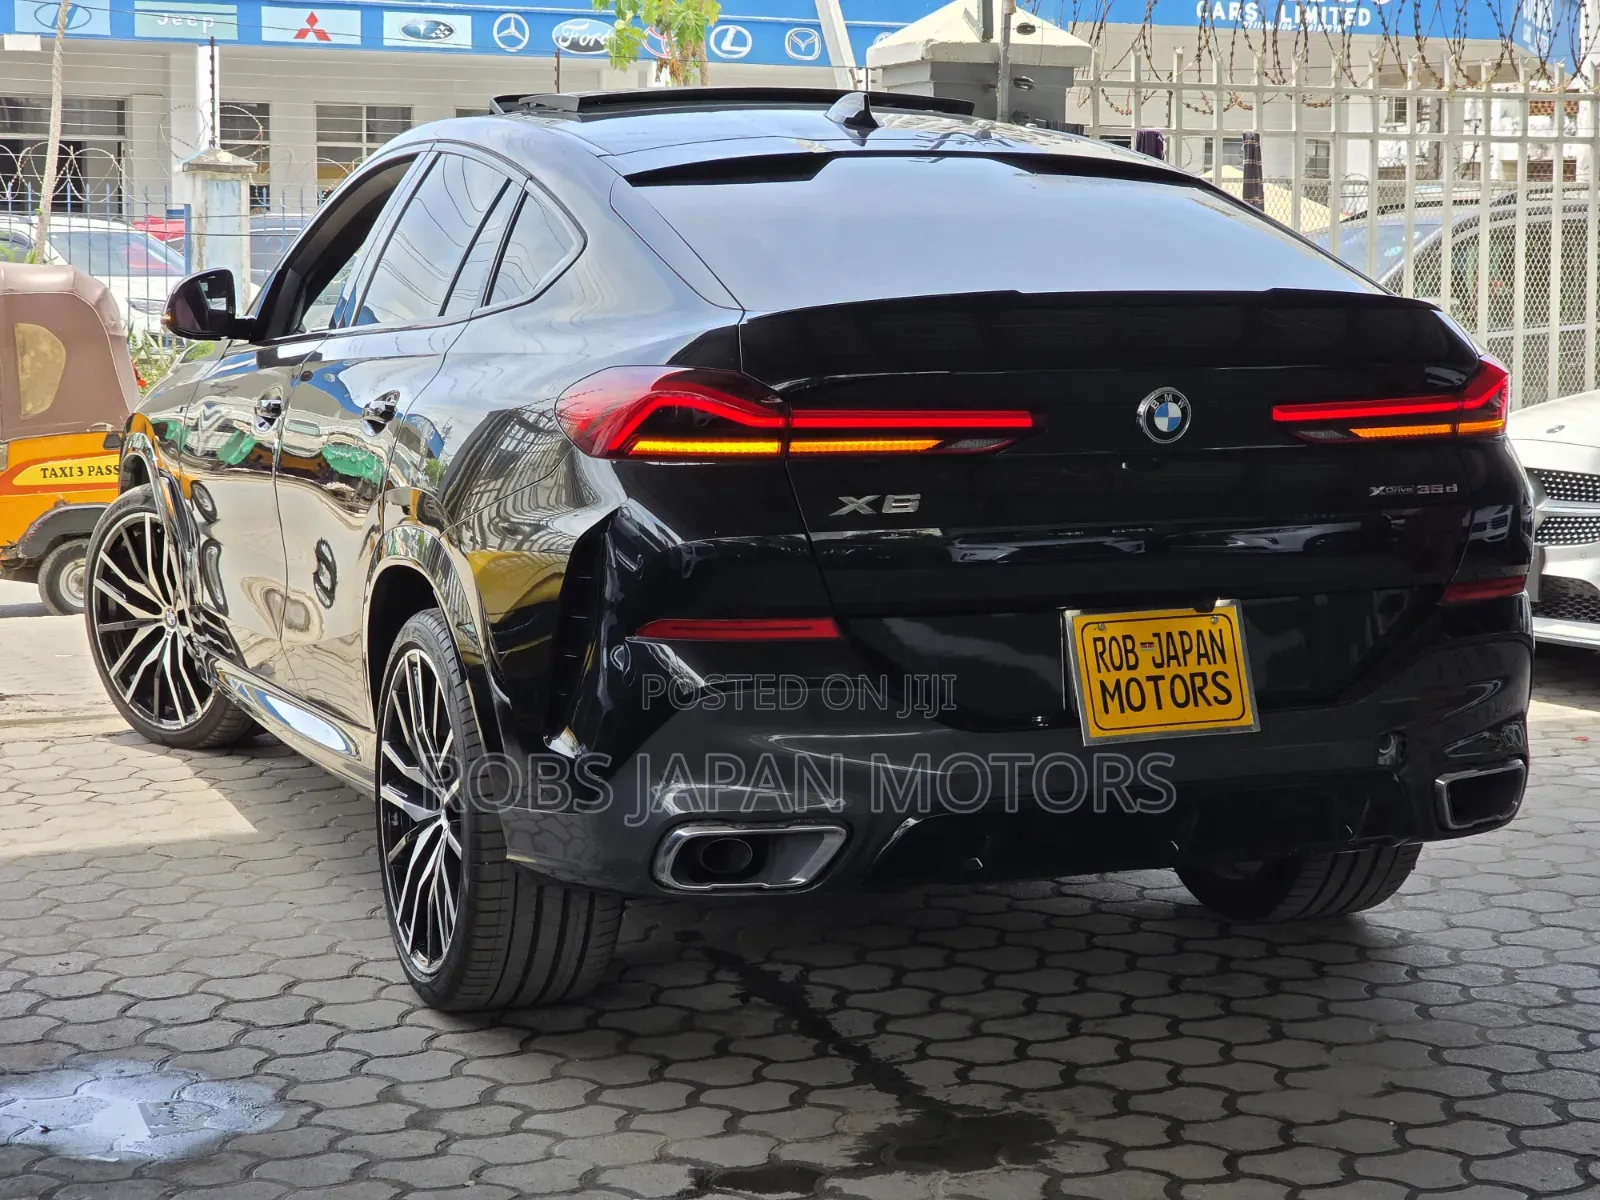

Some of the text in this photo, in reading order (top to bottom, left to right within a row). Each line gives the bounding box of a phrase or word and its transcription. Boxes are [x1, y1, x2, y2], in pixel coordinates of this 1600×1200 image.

[156, 13, 215, 34] Jeep
[1196, 1, 1371, 27] CARS LIMITED
[1150, 393, 1186, 410] BMW
[41, 466, 74, 479] TAXI
[76, 466, 84, 477] 3
[829, 493, 921, 517] X6
[1093, 628, 1227, 674] ROB JAPAN
[1099, 670, 1233, 715] MOTORS
